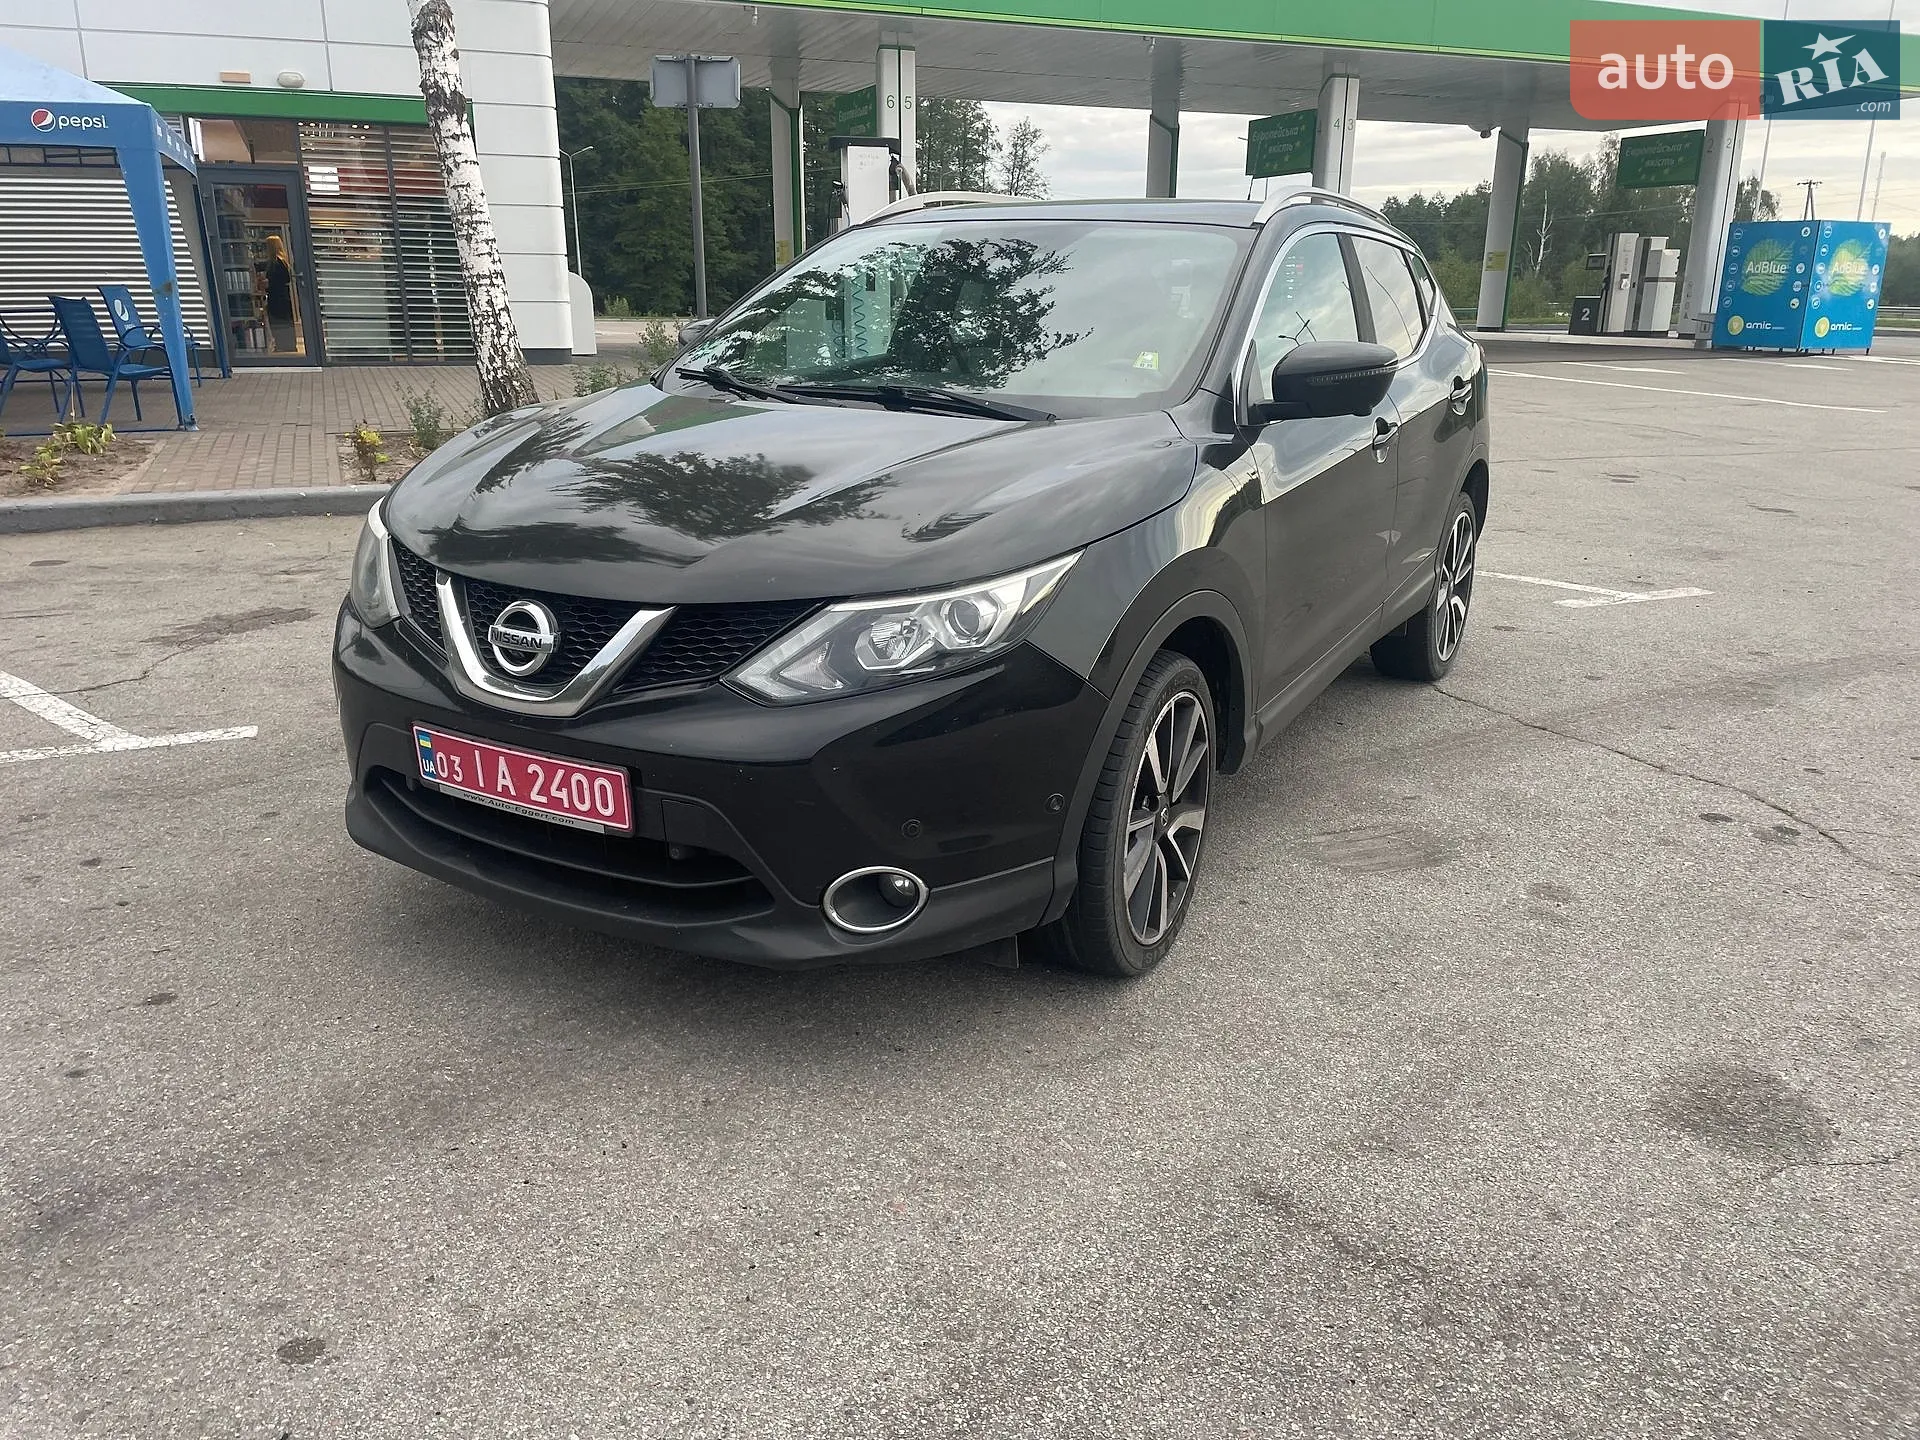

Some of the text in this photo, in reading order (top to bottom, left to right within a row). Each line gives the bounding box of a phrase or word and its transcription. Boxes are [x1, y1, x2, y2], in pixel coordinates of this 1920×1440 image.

[886, 94, 912, 110] 6 5
[58, 114, 107, 131] pepsi
[1333, 118, 1354, 131] 4 3
[1746, 260, 1788, 274] AdBlue
[1831, 261, 1867, 274] AdBlue
[1581, 307, 1591, 321] 2
[1745, 320, 1772, 330] amic
[1830, 321, 1853, 331] amic
[490, 626, 543, 649] NISSAN
[422, 758, 437, 775] UA
[435, 751, 464, 783] 03
[527, 763, 615, 817] 2400
[463, 792, 575, 825] www.Auto-Eggert.com
